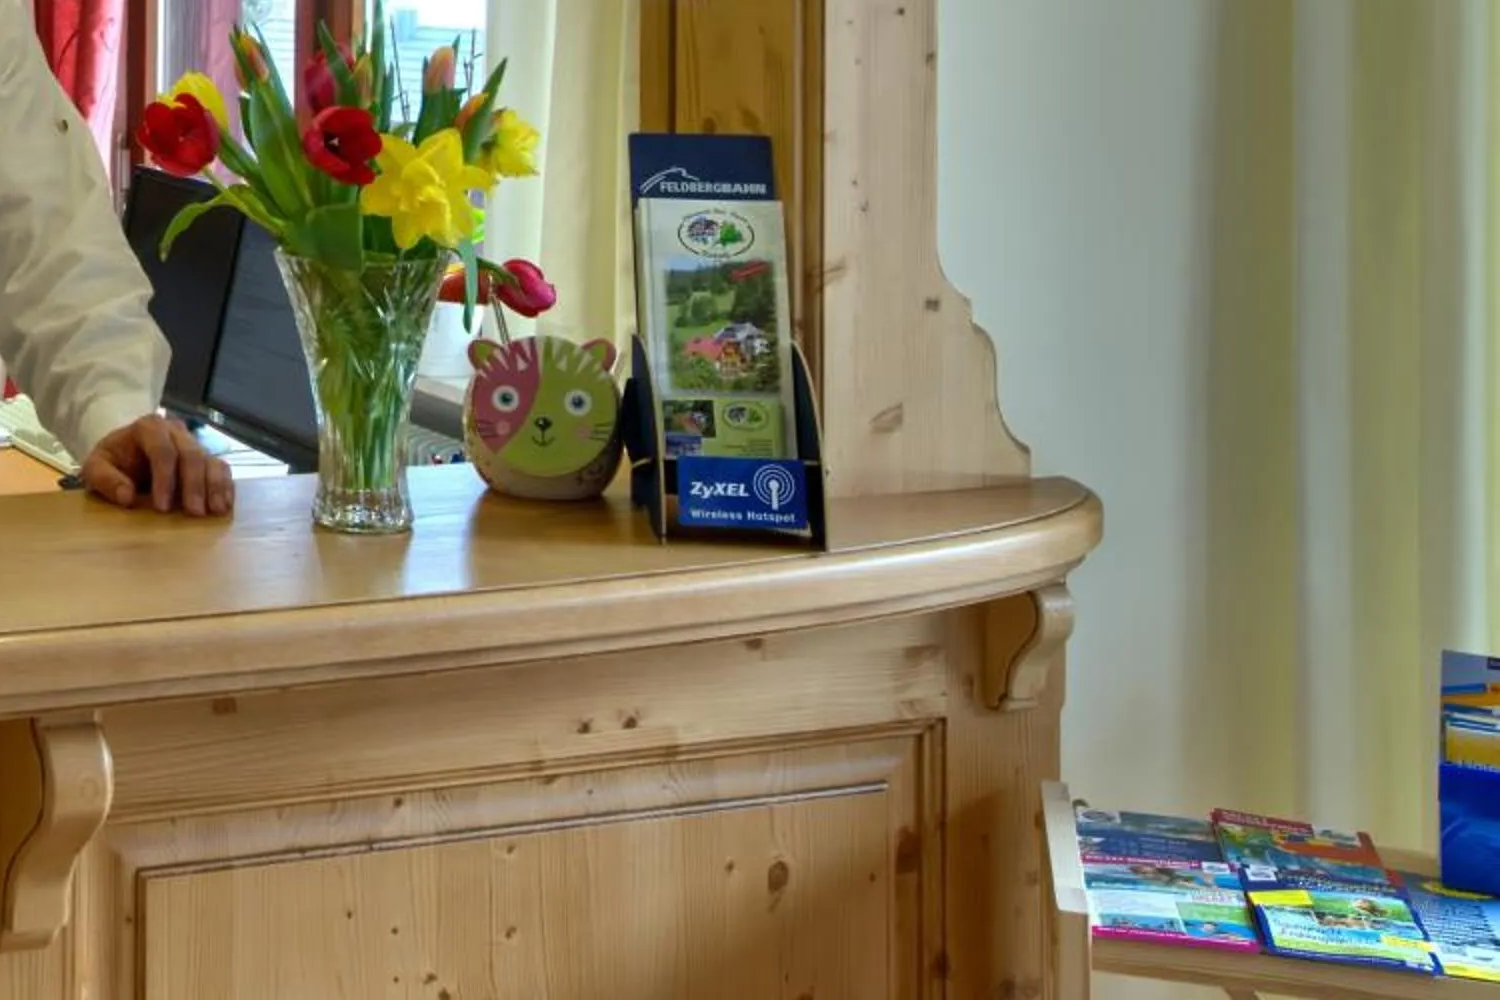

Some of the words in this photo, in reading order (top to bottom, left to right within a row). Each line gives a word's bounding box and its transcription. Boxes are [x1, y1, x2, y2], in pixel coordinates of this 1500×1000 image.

[660, 181, 767, 195] FELDBERGBAHN
[690, 481, 750, 499] ZyXEL
[690, 508, 743, 521] Wireless
[747, 511, 796, 524] Hotspot
